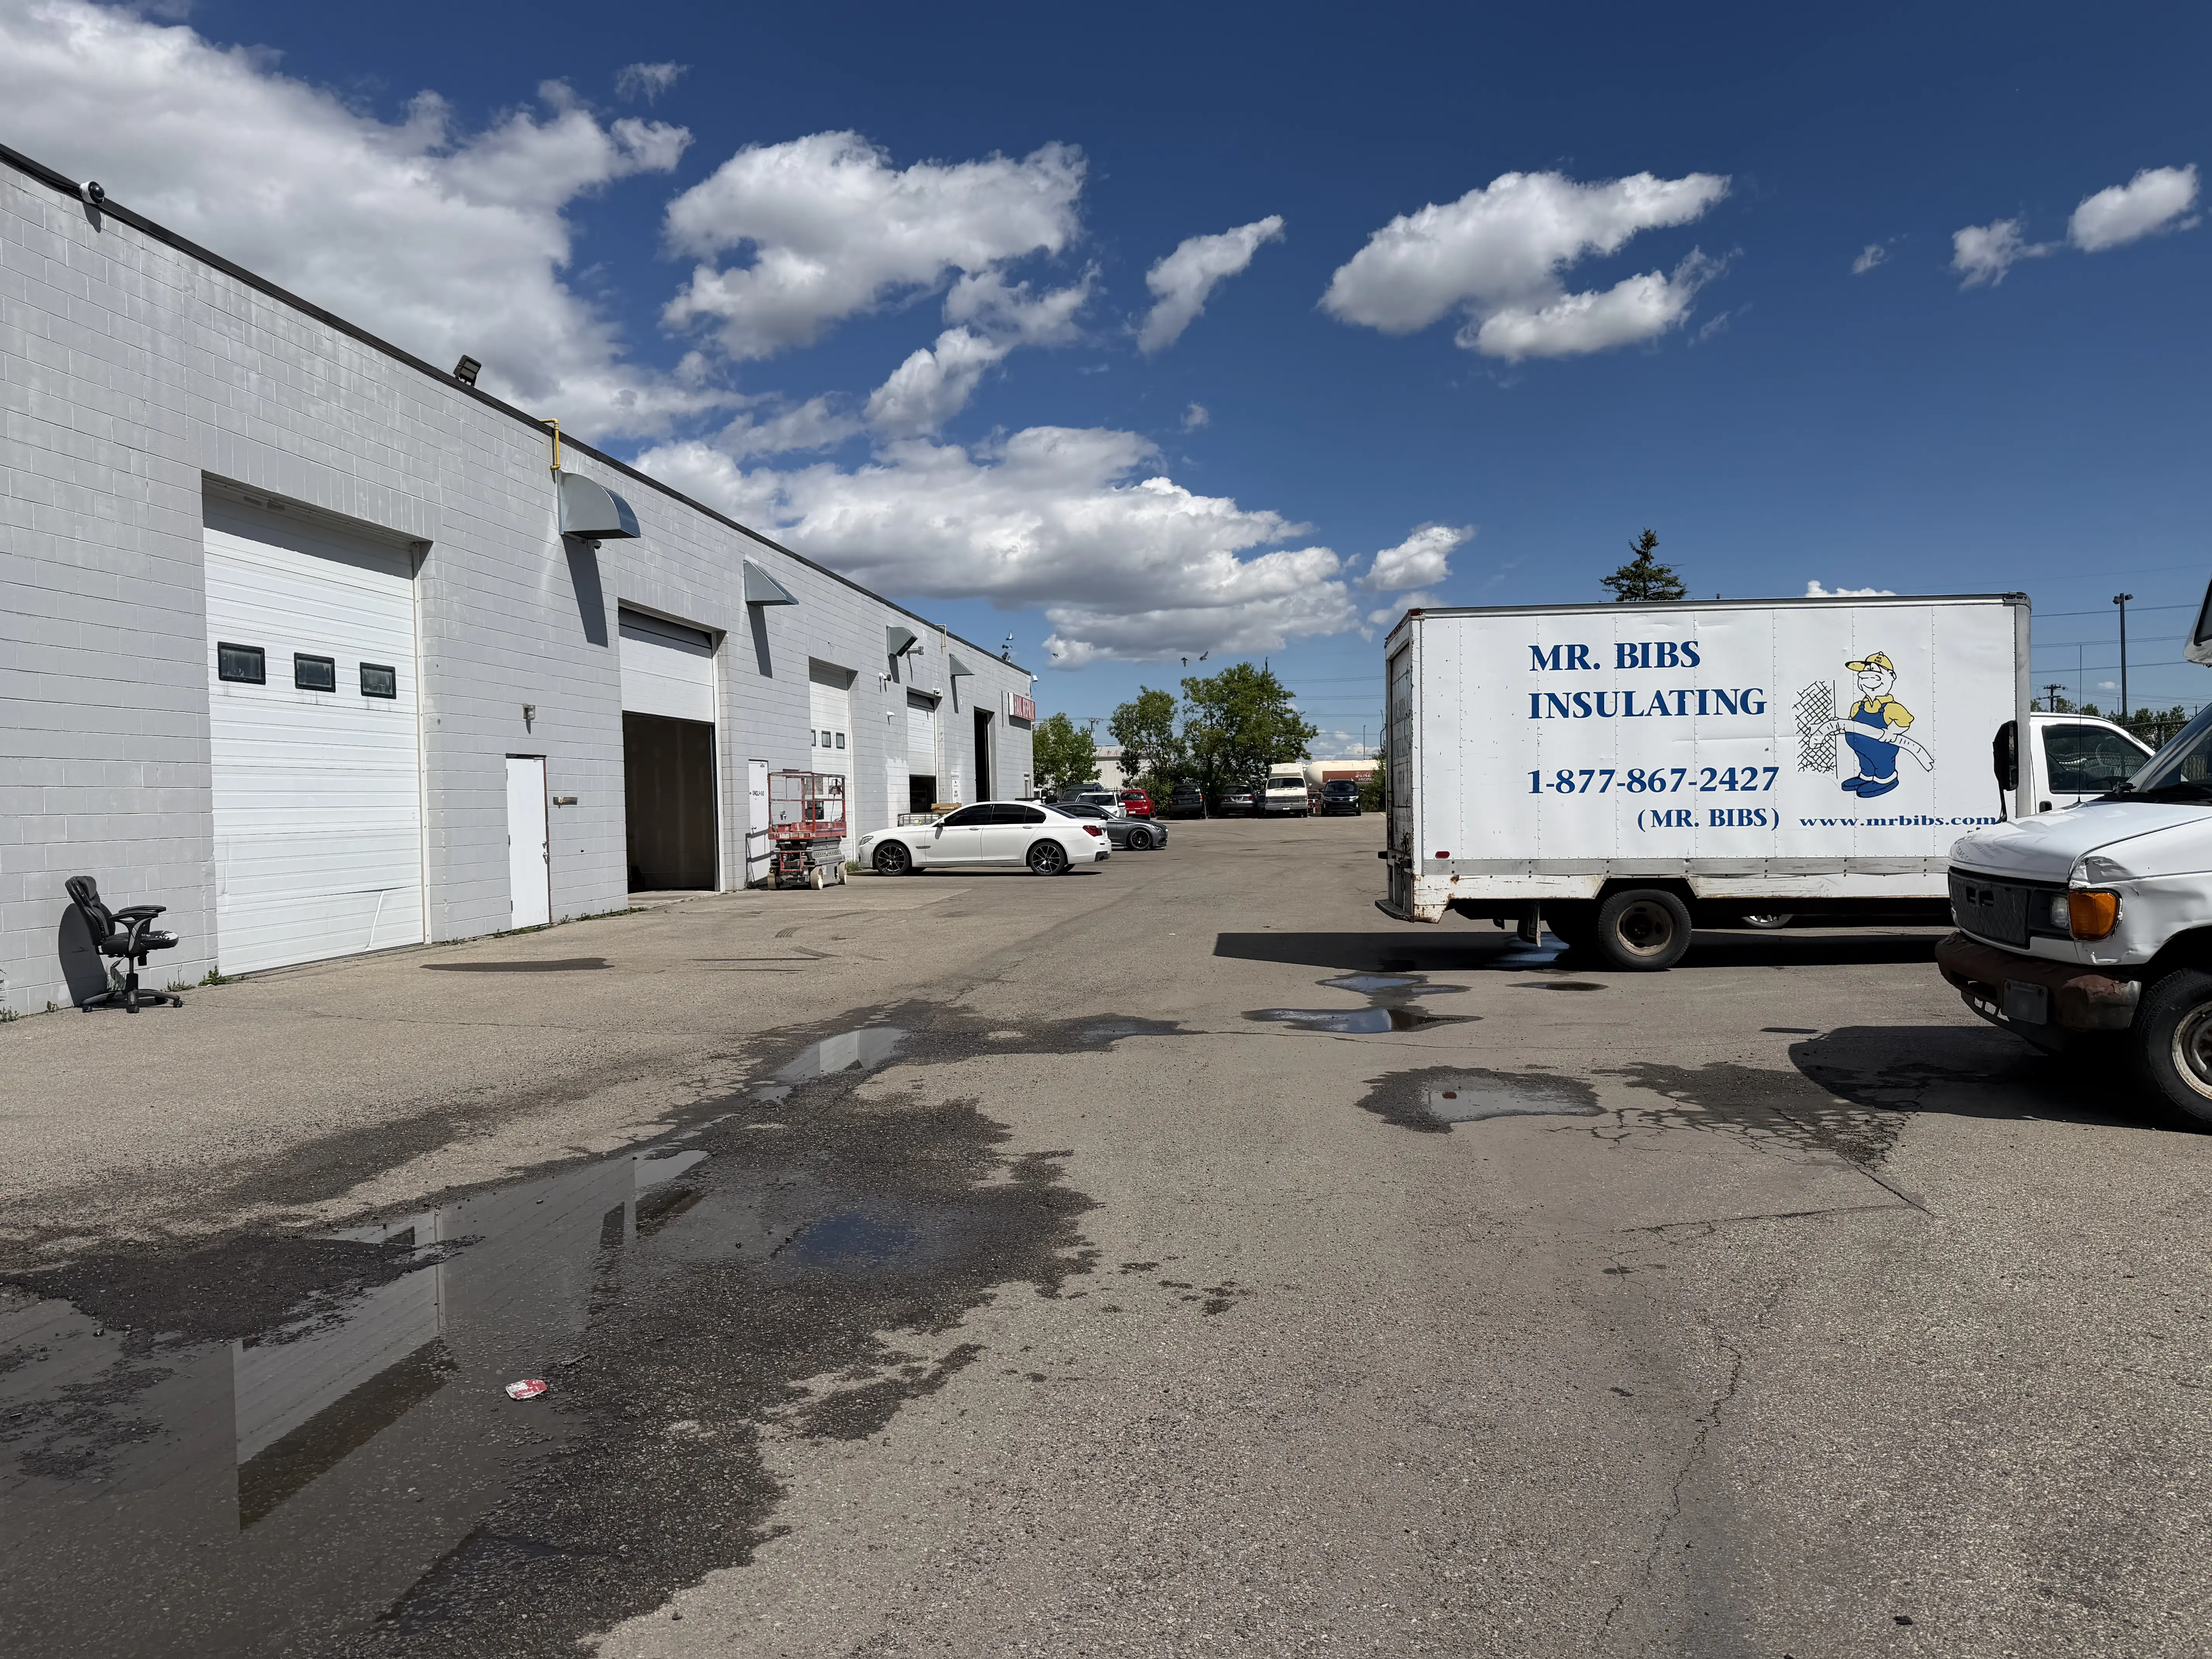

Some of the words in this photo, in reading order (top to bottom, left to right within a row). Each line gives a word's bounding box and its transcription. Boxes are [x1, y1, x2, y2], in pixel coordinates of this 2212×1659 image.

[1528, 644, 1600, 671] MR.
[1614, 641, 1700, 669] BIBS
[1528, 688, 1767, 719] INSULATING
[1528, 766, 1779, 793] 1-877-867-2427
[1708, 809, 1779, 830] BIBS)
[1799, 815, 1996, 826] www.mrbibs.com
